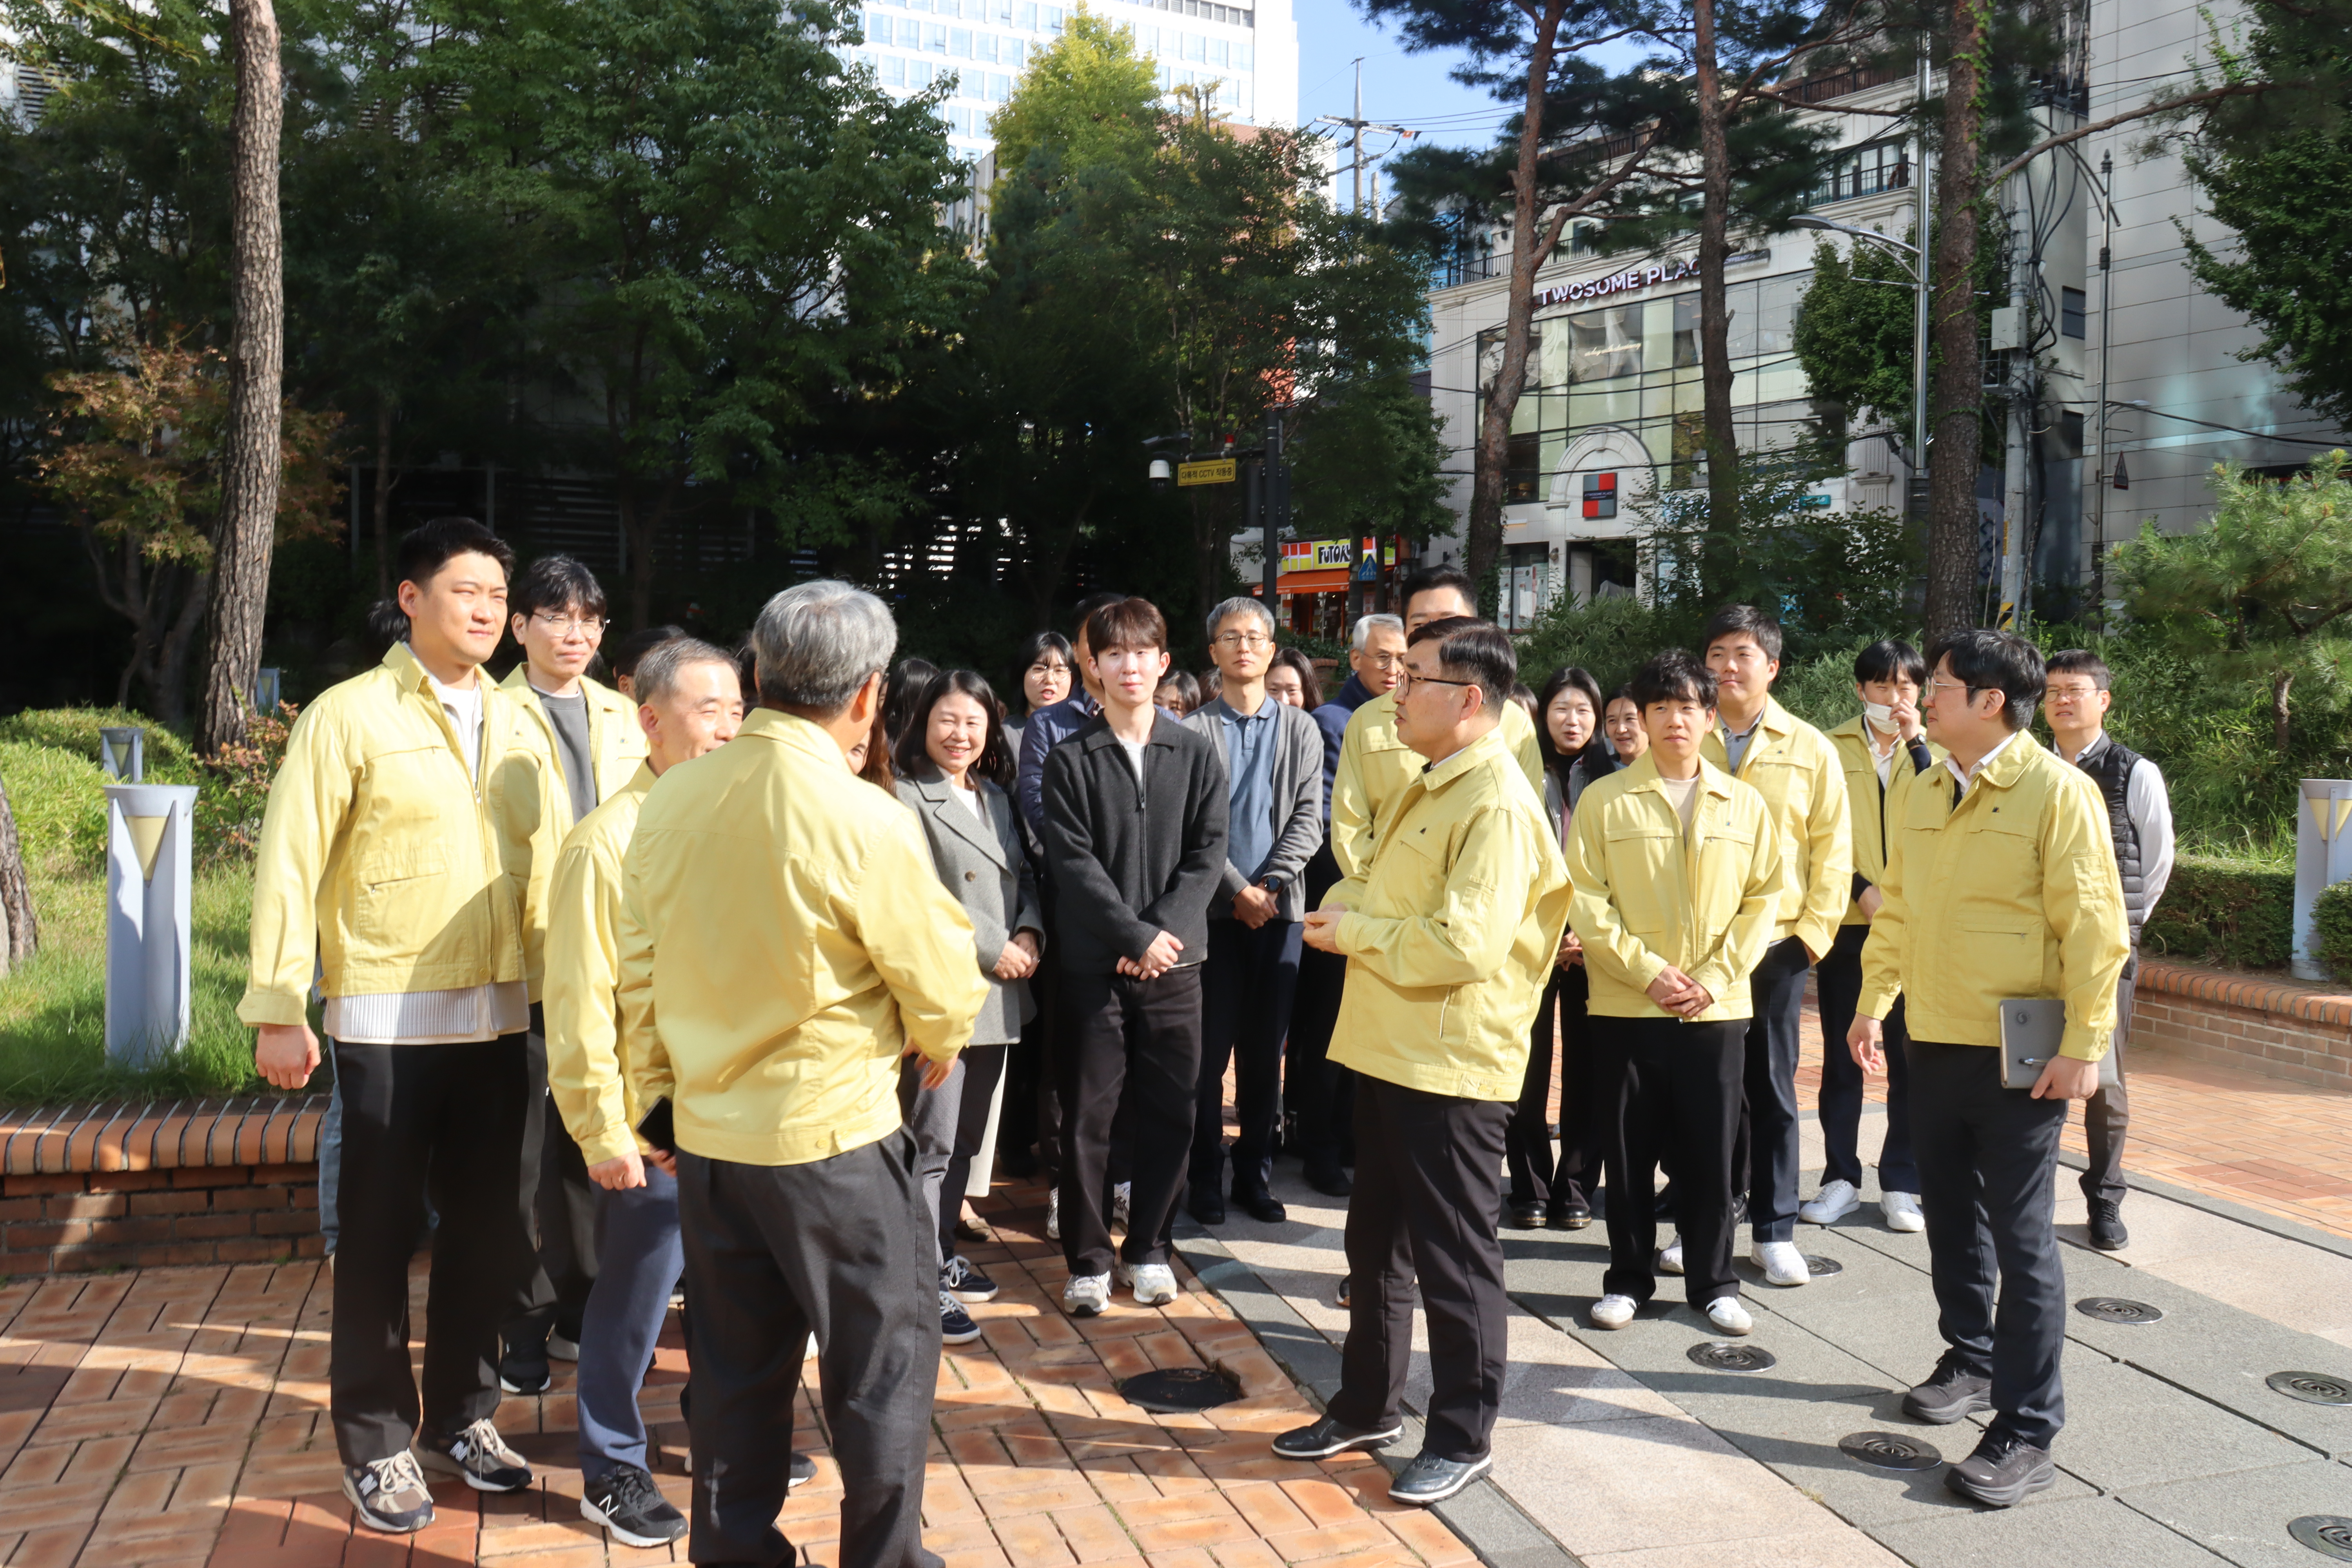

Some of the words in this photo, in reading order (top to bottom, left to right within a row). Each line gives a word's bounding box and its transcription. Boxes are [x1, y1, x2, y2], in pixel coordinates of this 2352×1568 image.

[1539, 271, 1640, 305] TWOSOME
[1647, 258, 1701, 285] PLAC
[1199, 469, 1214, 478] CCTV
[358, 1473, 379, 1497] N
